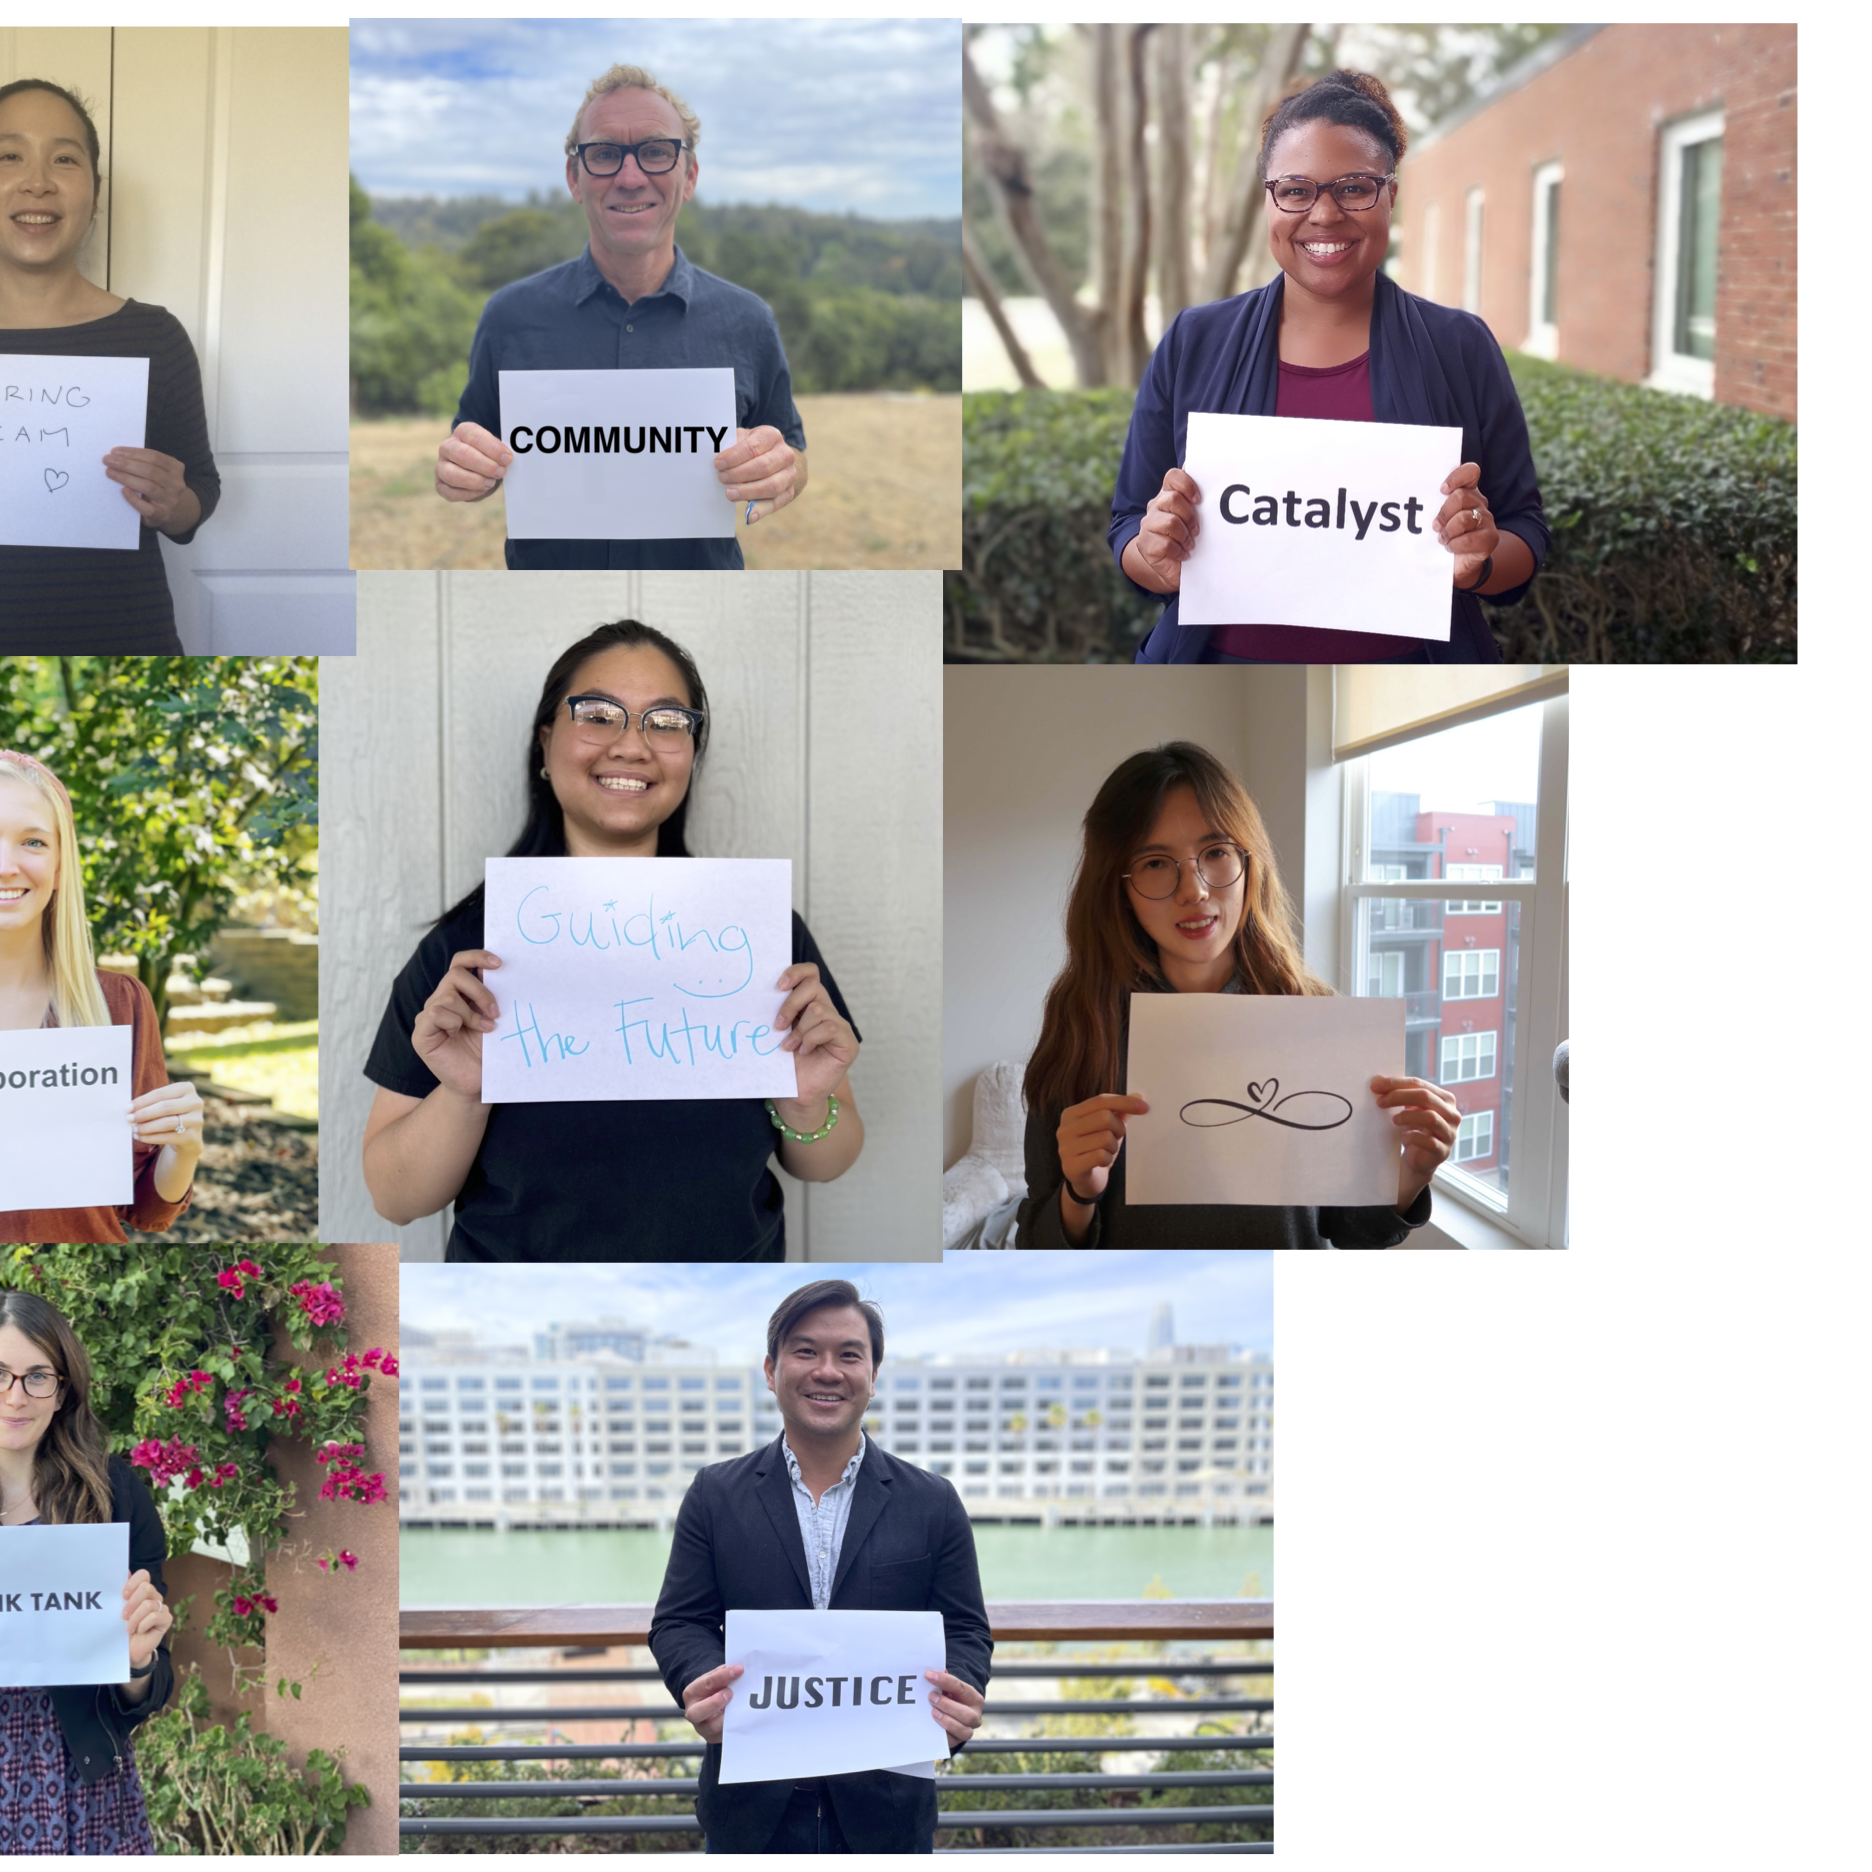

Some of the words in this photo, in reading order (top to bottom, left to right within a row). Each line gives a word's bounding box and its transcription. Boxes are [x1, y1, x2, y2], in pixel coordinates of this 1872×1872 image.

[509, 425, 728, 454] COMMUNITY
[1219, 483, 1424, 540] Catalyst
[517, 886, 753, 998] Guiding
[500, 999, 590, 1068] the
[613, 997, 781, 1066] Future
[31, 1591, 103, 1611] TANK
[749, 1674, 918, 1710] JUSTICE
